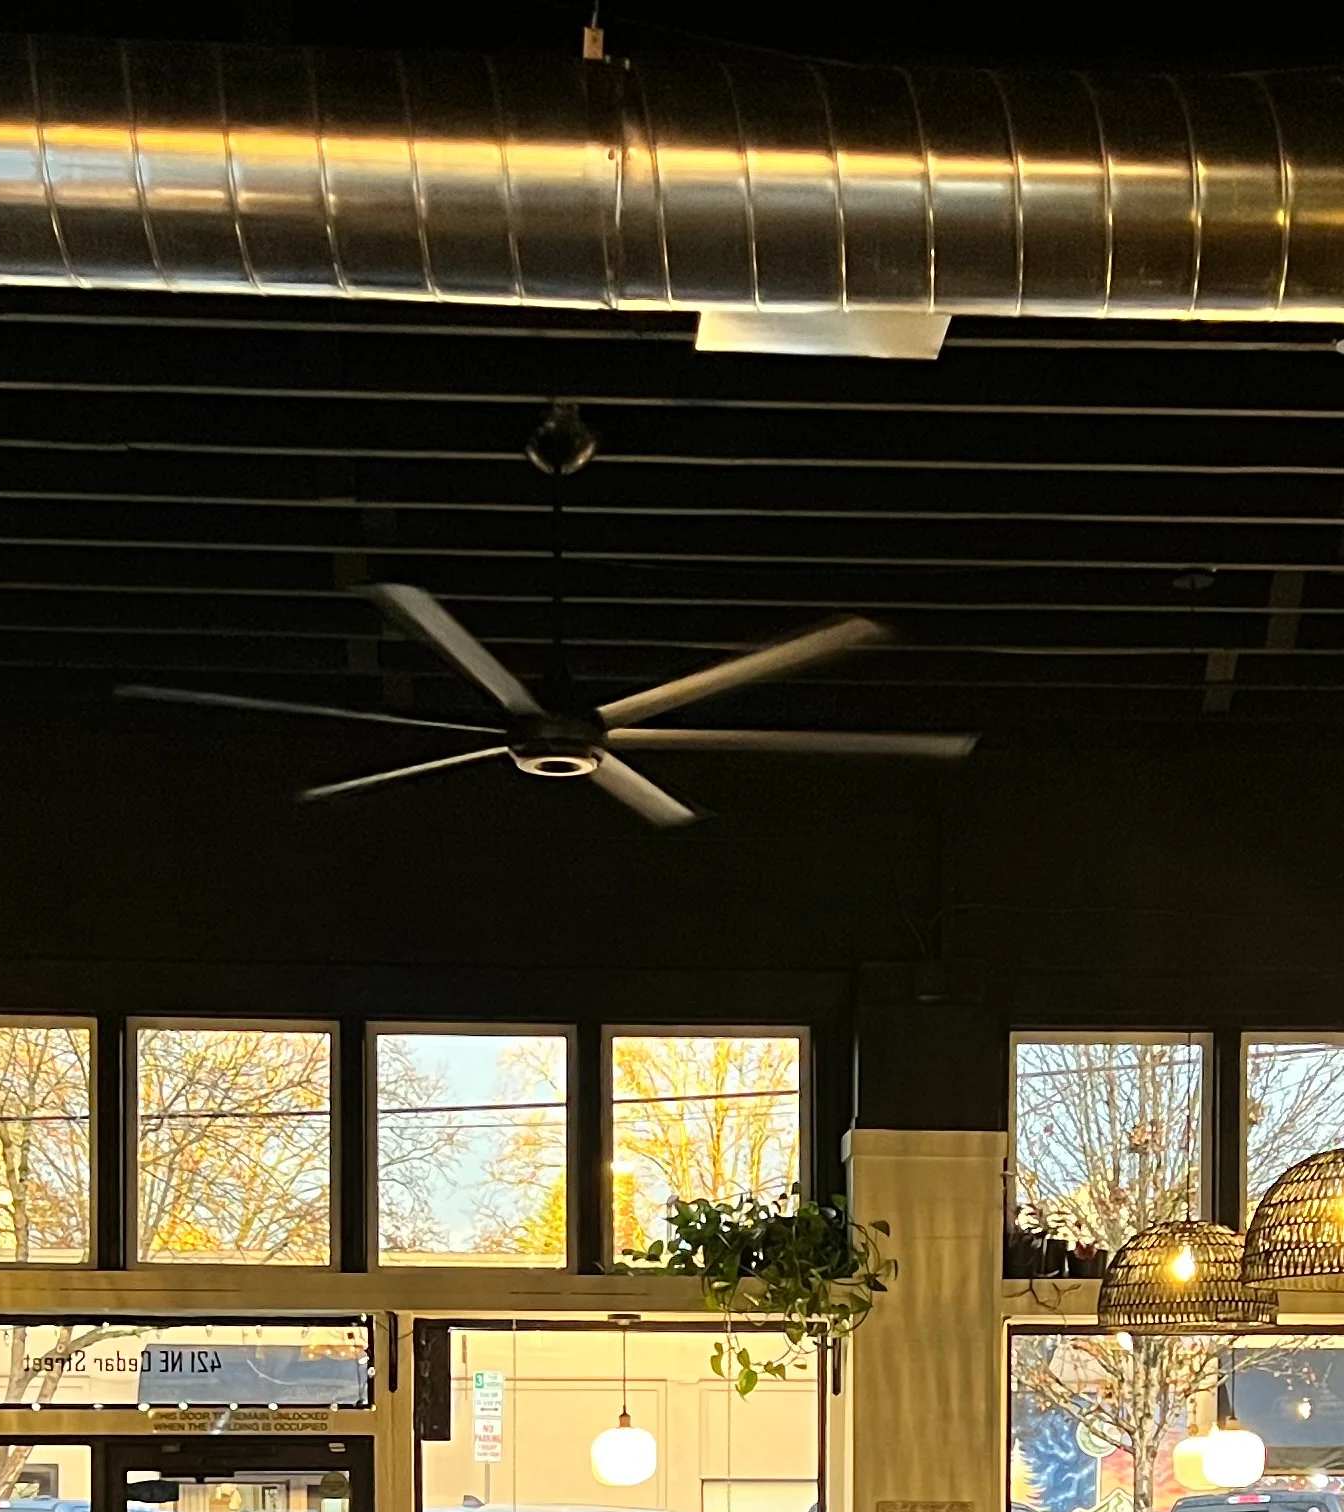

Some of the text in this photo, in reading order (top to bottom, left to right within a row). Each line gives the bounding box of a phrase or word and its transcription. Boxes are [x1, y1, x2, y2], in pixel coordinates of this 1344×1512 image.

[179, 1411, 210, 1421] DOOR
[271, 1411, 329, 1421] UNLOCKED
[154, 1422, 328, 1431] WHEN THE BLDING IS OCCUPIED
